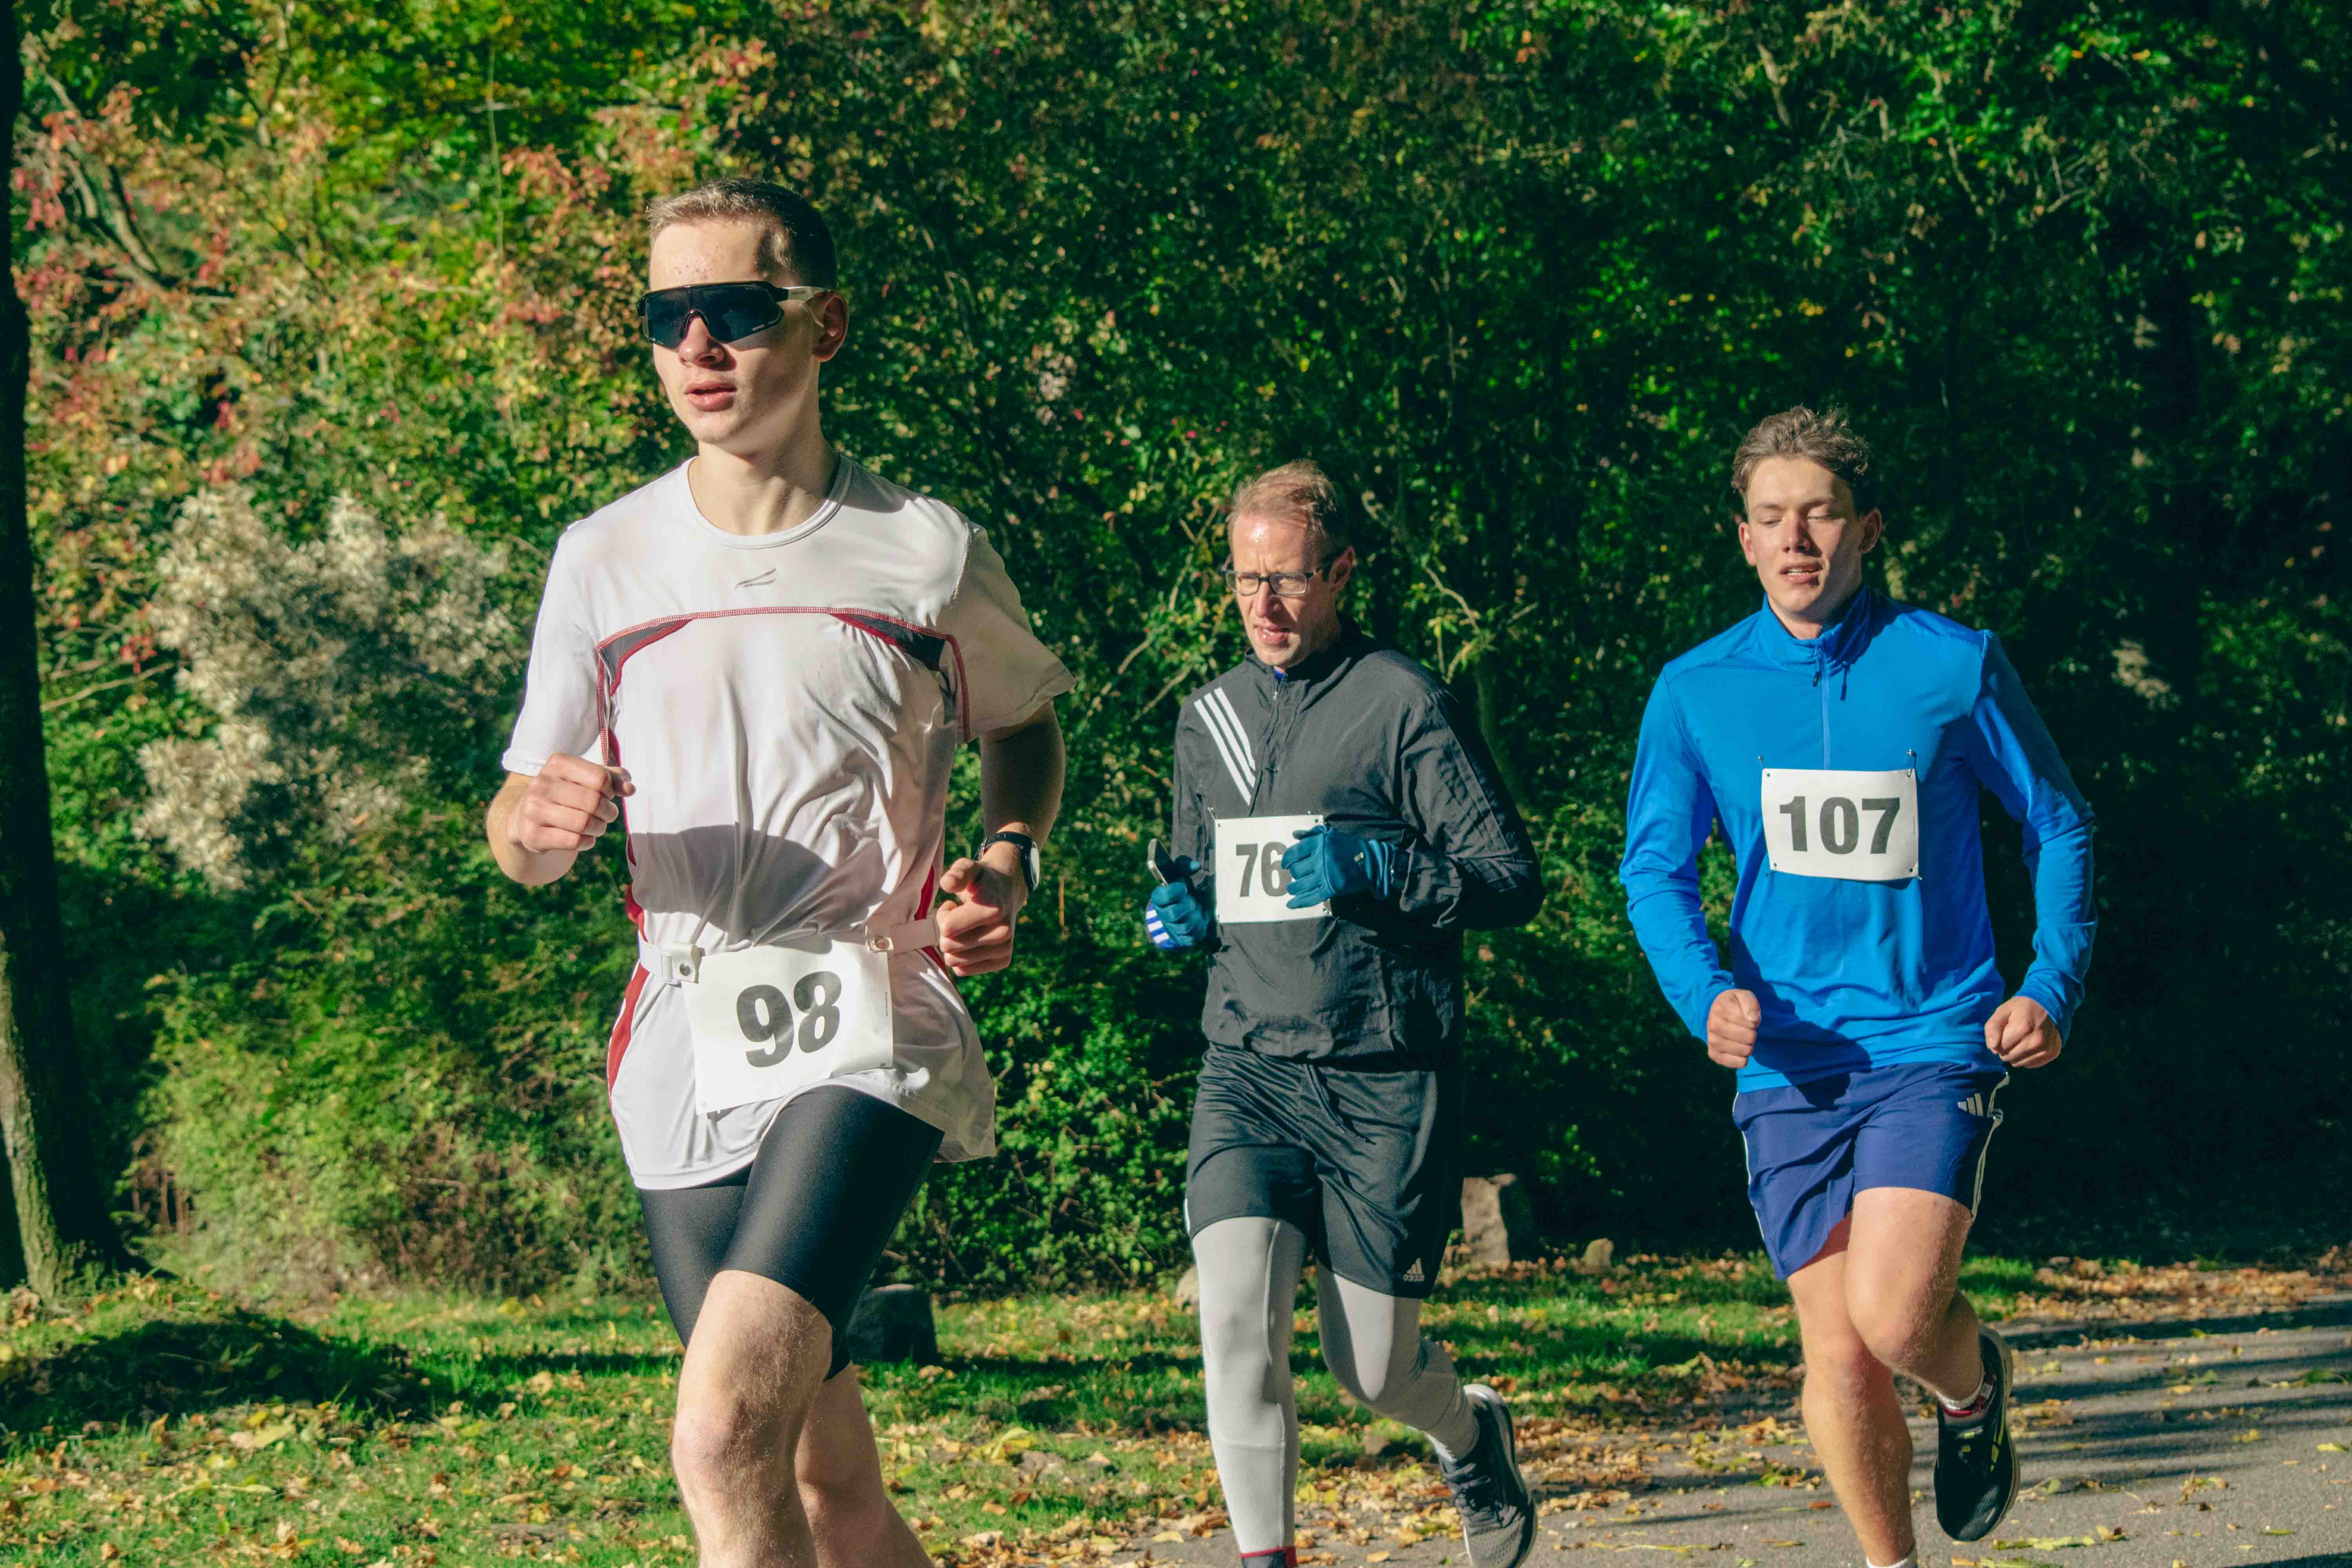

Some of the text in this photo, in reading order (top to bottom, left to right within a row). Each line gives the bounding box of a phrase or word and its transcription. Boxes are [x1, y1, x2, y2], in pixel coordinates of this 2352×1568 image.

[1779, 795, 1900, 855] 107
[1236, 841, 1291, 897] 76
[736, 970, 842, 1067] 98
[1403, 1274, 1425, 1282] adidas
